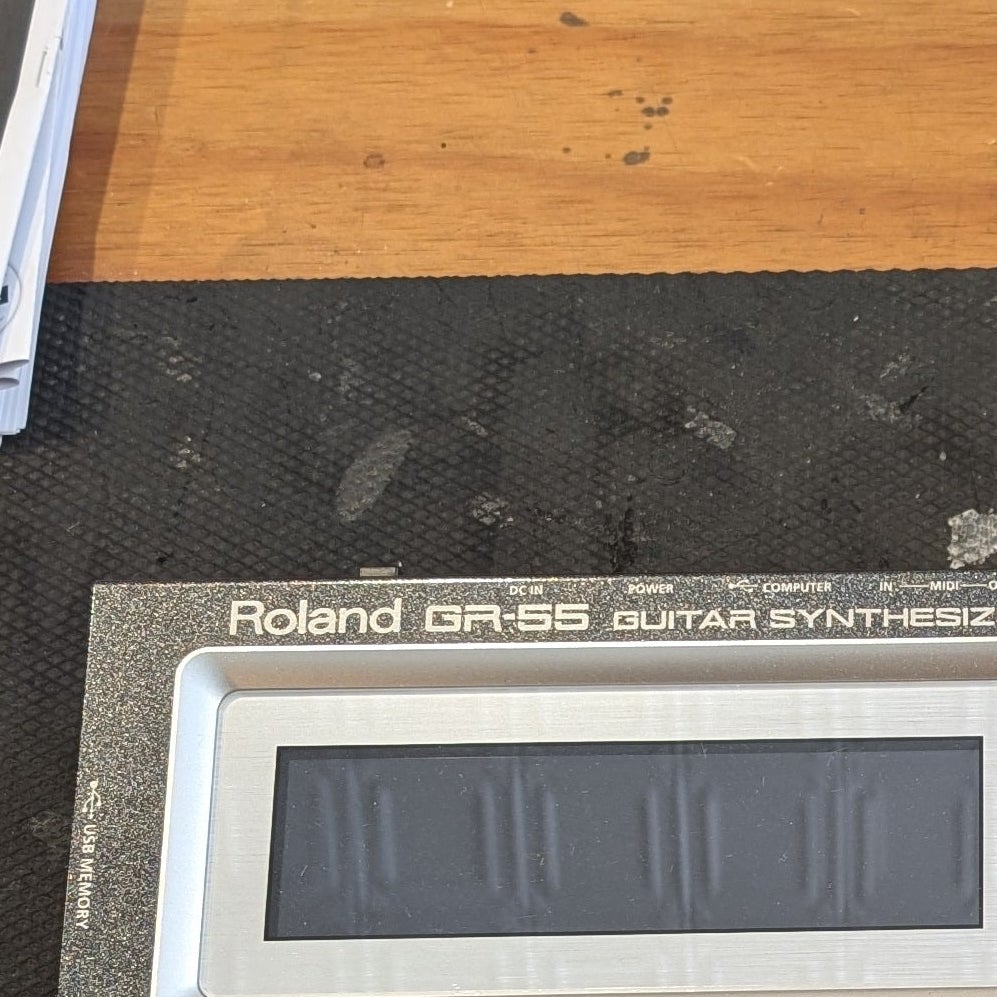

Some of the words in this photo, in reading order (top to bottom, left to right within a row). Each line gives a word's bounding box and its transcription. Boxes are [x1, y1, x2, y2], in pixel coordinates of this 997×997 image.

[509, 586, 526, 595] DC
[528, 586, 543, 595] IN
[628, 583, 673, 595] POWER
[762, 581, 832, 592] COMPUTER
[879, 581, 892, 592] IN
[929, 580, 960, 592] MIDI
[229, 598, 402, 637] Roland
[425, 603, 590, 632] GR-55
[613, 609, 756, 631] GUITAR
[82, 825, 96, 853] USB
[75, 858, 94, 930] MEMORY
